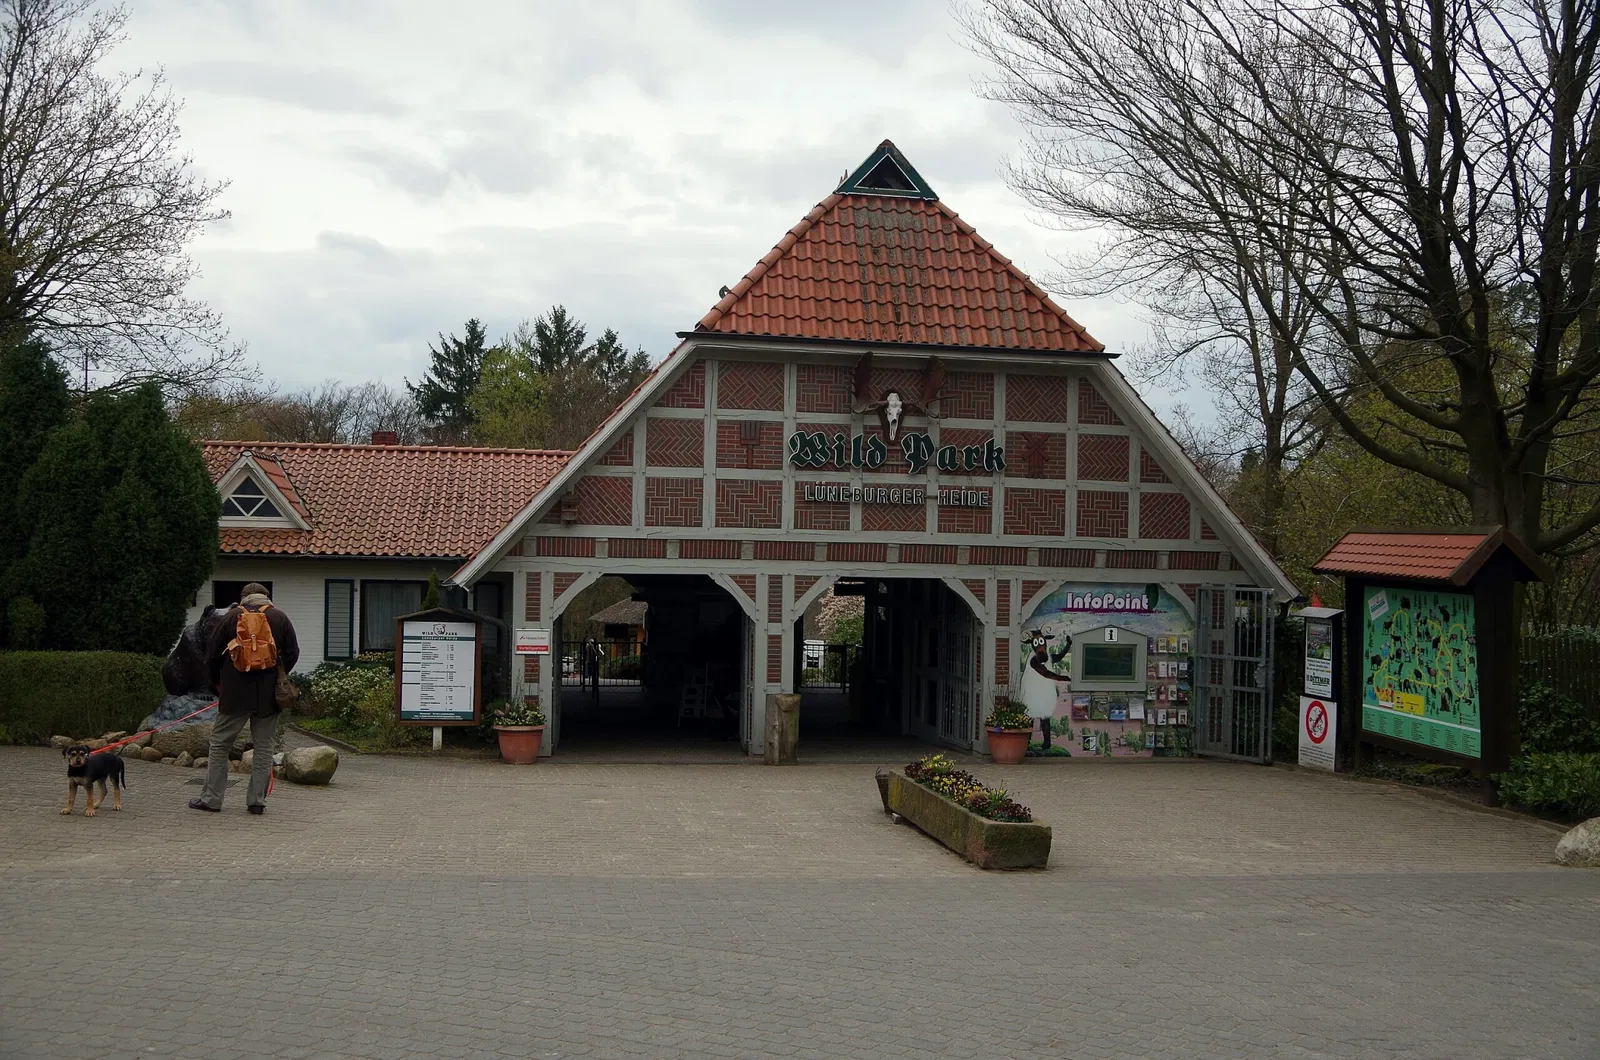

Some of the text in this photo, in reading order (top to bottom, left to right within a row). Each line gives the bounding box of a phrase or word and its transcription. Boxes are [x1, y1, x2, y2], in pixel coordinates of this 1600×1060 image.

[788, 430, 1007, 474] Wild Park
[804, 481, 925, 505] LÜNEBURGER
[1067, 592, 1149, 609] InfoPoint
